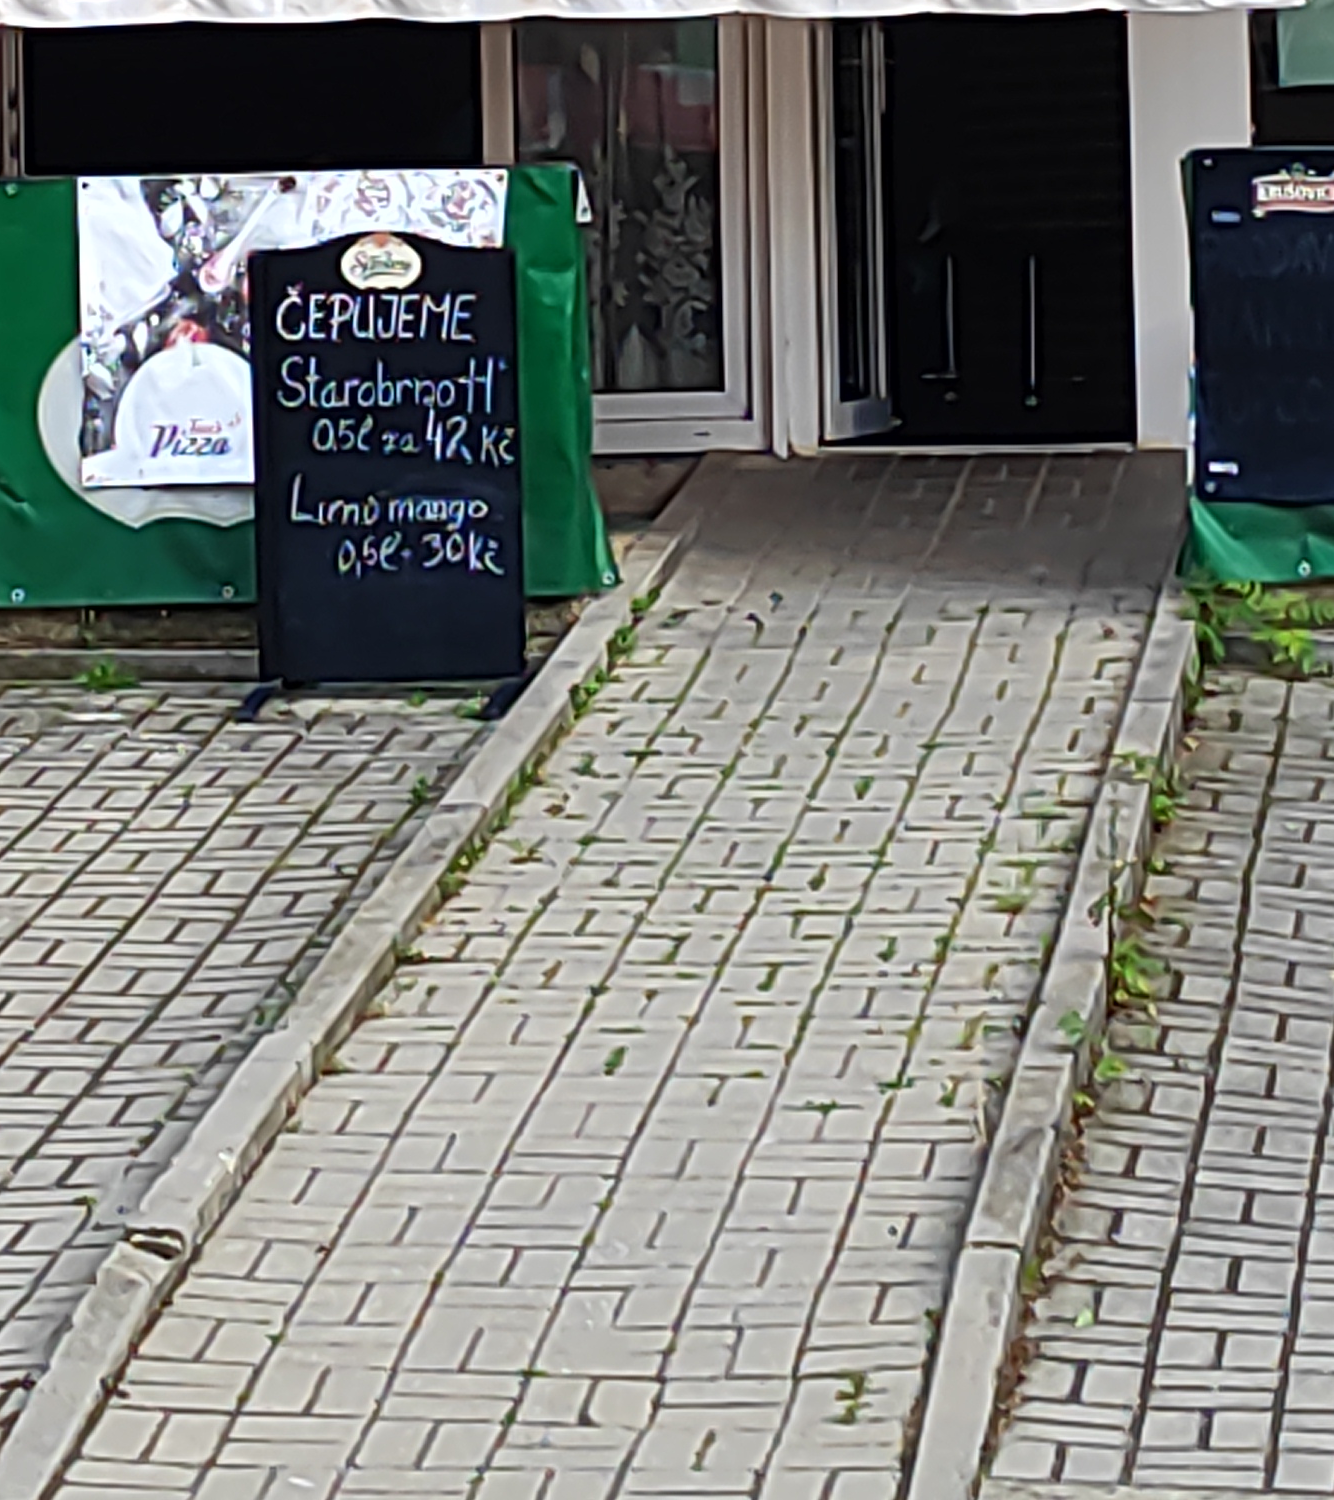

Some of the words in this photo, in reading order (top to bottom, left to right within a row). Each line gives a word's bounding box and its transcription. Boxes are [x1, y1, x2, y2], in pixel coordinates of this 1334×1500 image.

[275, 282, 479, 342] ČEPUJEME
[276, 356, 455, 408] Starobrno
[149, 423, 234, 458] Pizza
[480, 425, 516, 468] Kč
[388, 496, 489, 532] mango
